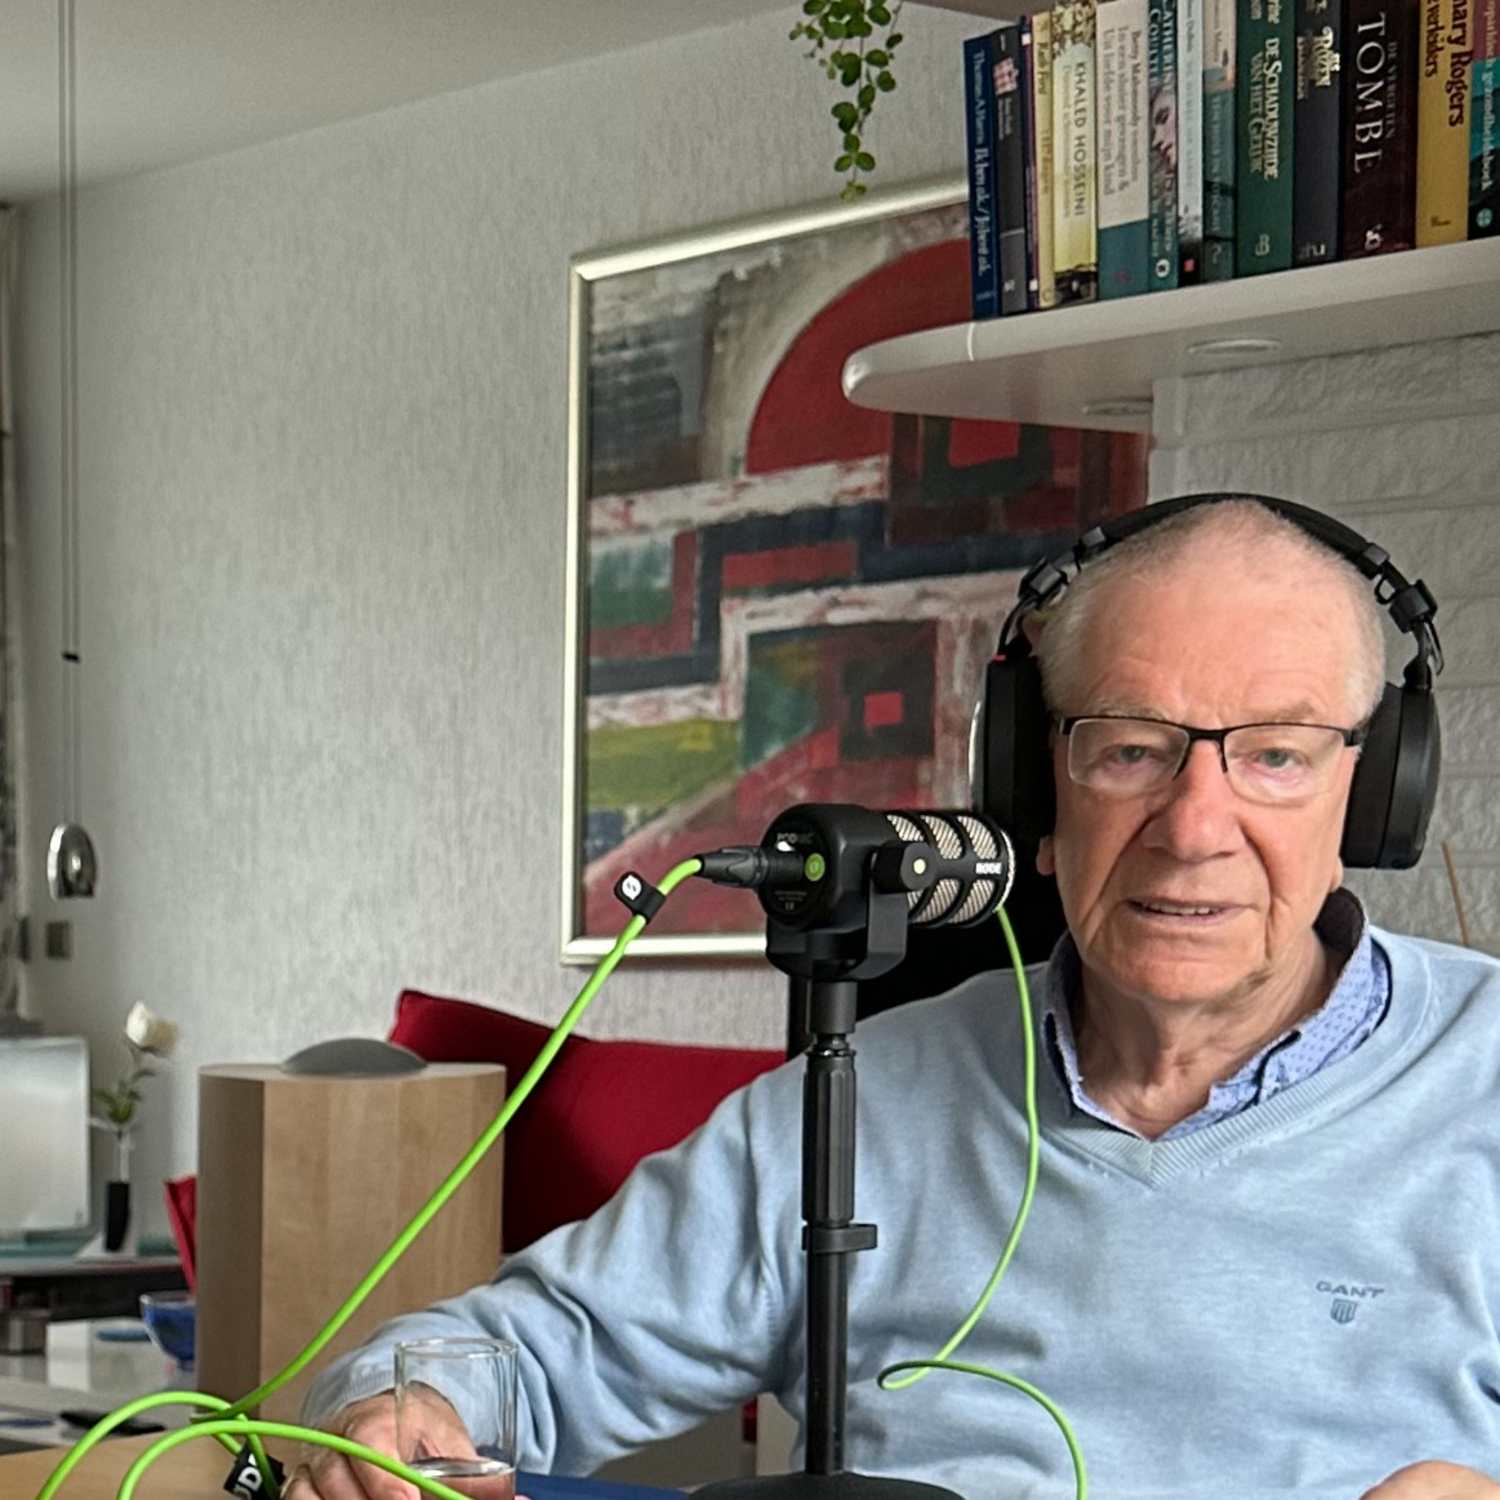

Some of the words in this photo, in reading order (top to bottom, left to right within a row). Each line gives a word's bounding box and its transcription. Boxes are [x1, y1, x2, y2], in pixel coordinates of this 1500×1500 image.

[1103, 28, 1115, 49] Uit
[1266, 37, 1280, 58] DE
[1425, 4, 1445, 78] verleiders
[1103, 53, 1115, 92] liefde
[1118, 45, 1127, 71] een
[1250, 51, 1263, 82] VAN
[1075, 61, 1086, 128] KHALED
[1250, 84, 1263, 115] HET
[1354, 12, 1386, 173] TOMBE
[1445, 49, 1474, 127] Rogers
[1103, 95, 1112, 126] voor
[1100, 130, 1113, 161] mijn
[1480, 70, 1496, 191] gezondheidsboek
[1074, 134, 1086, 217] HOSSEINI
[1103, 163, 1115, 196] kind
[1316, 1280, 1386, 1299] GANT
